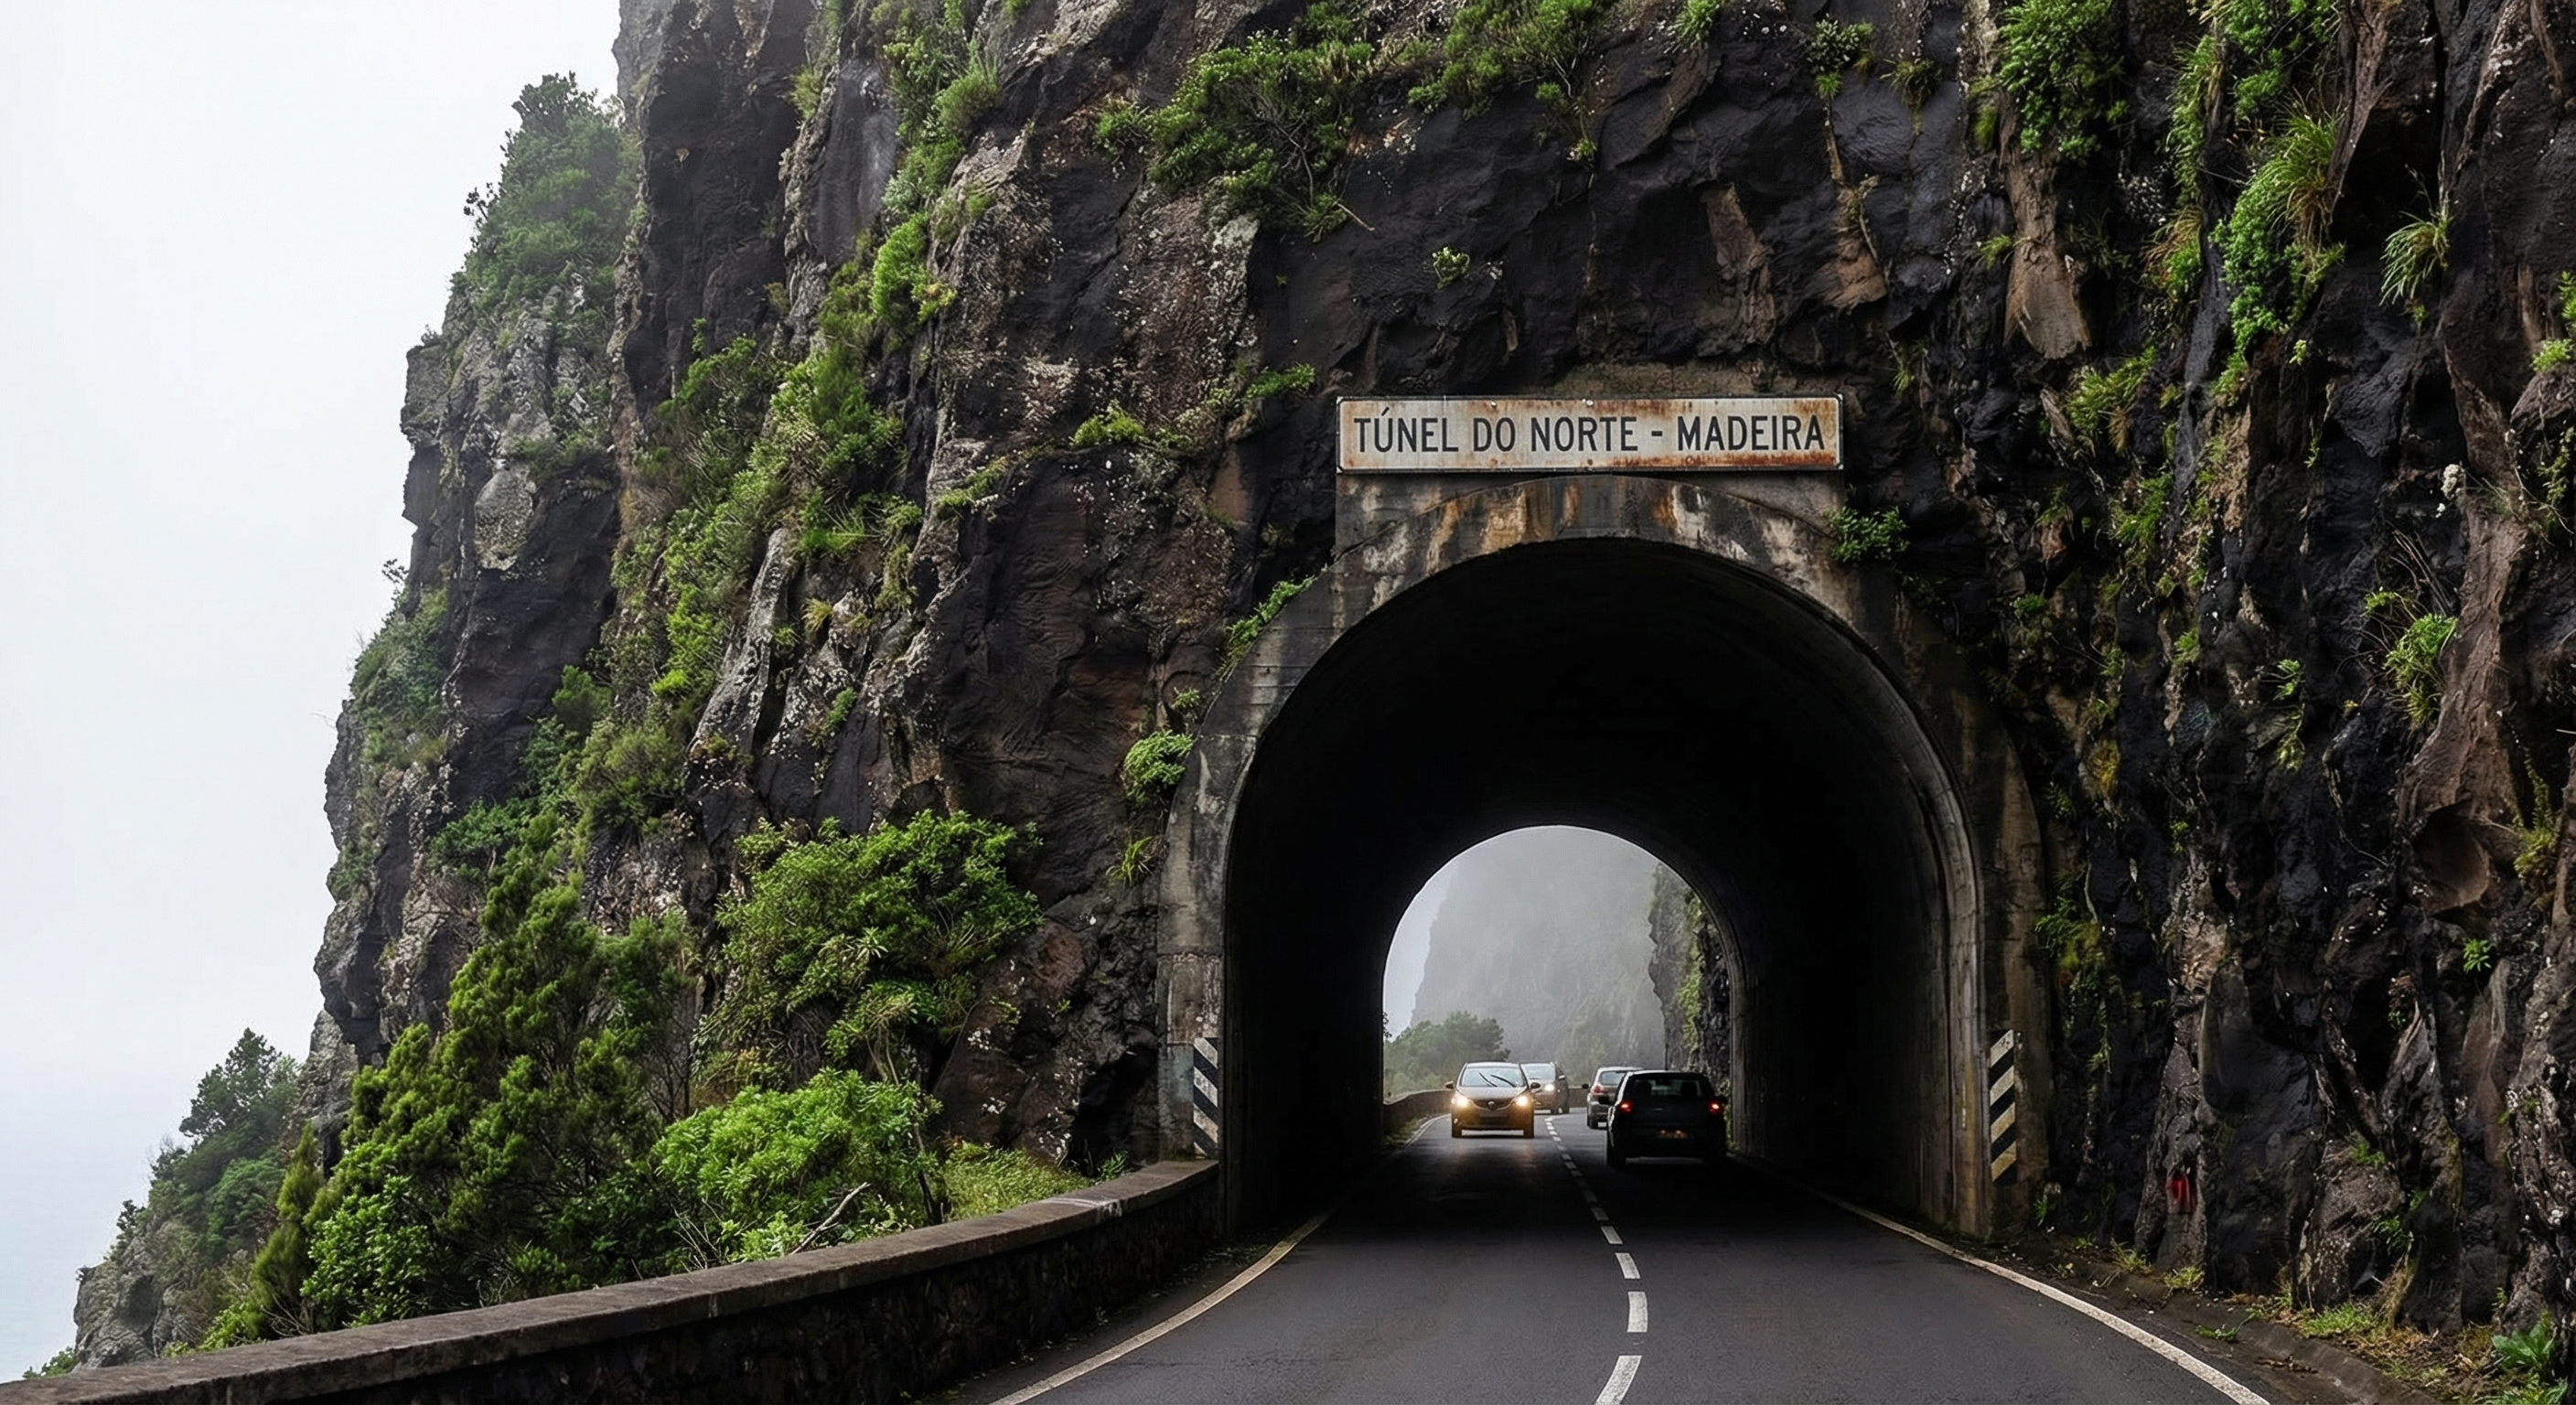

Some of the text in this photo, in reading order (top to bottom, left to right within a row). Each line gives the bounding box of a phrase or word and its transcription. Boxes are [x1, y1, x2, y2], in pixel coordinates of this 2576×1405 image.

[1353, 406, 1460, 453] TÚNEL
[1473, 417, 1516, 452] DO
[1530, 416, 1638, 452] NORTE
[1678, 414, 1825, 451] MADEIRA
